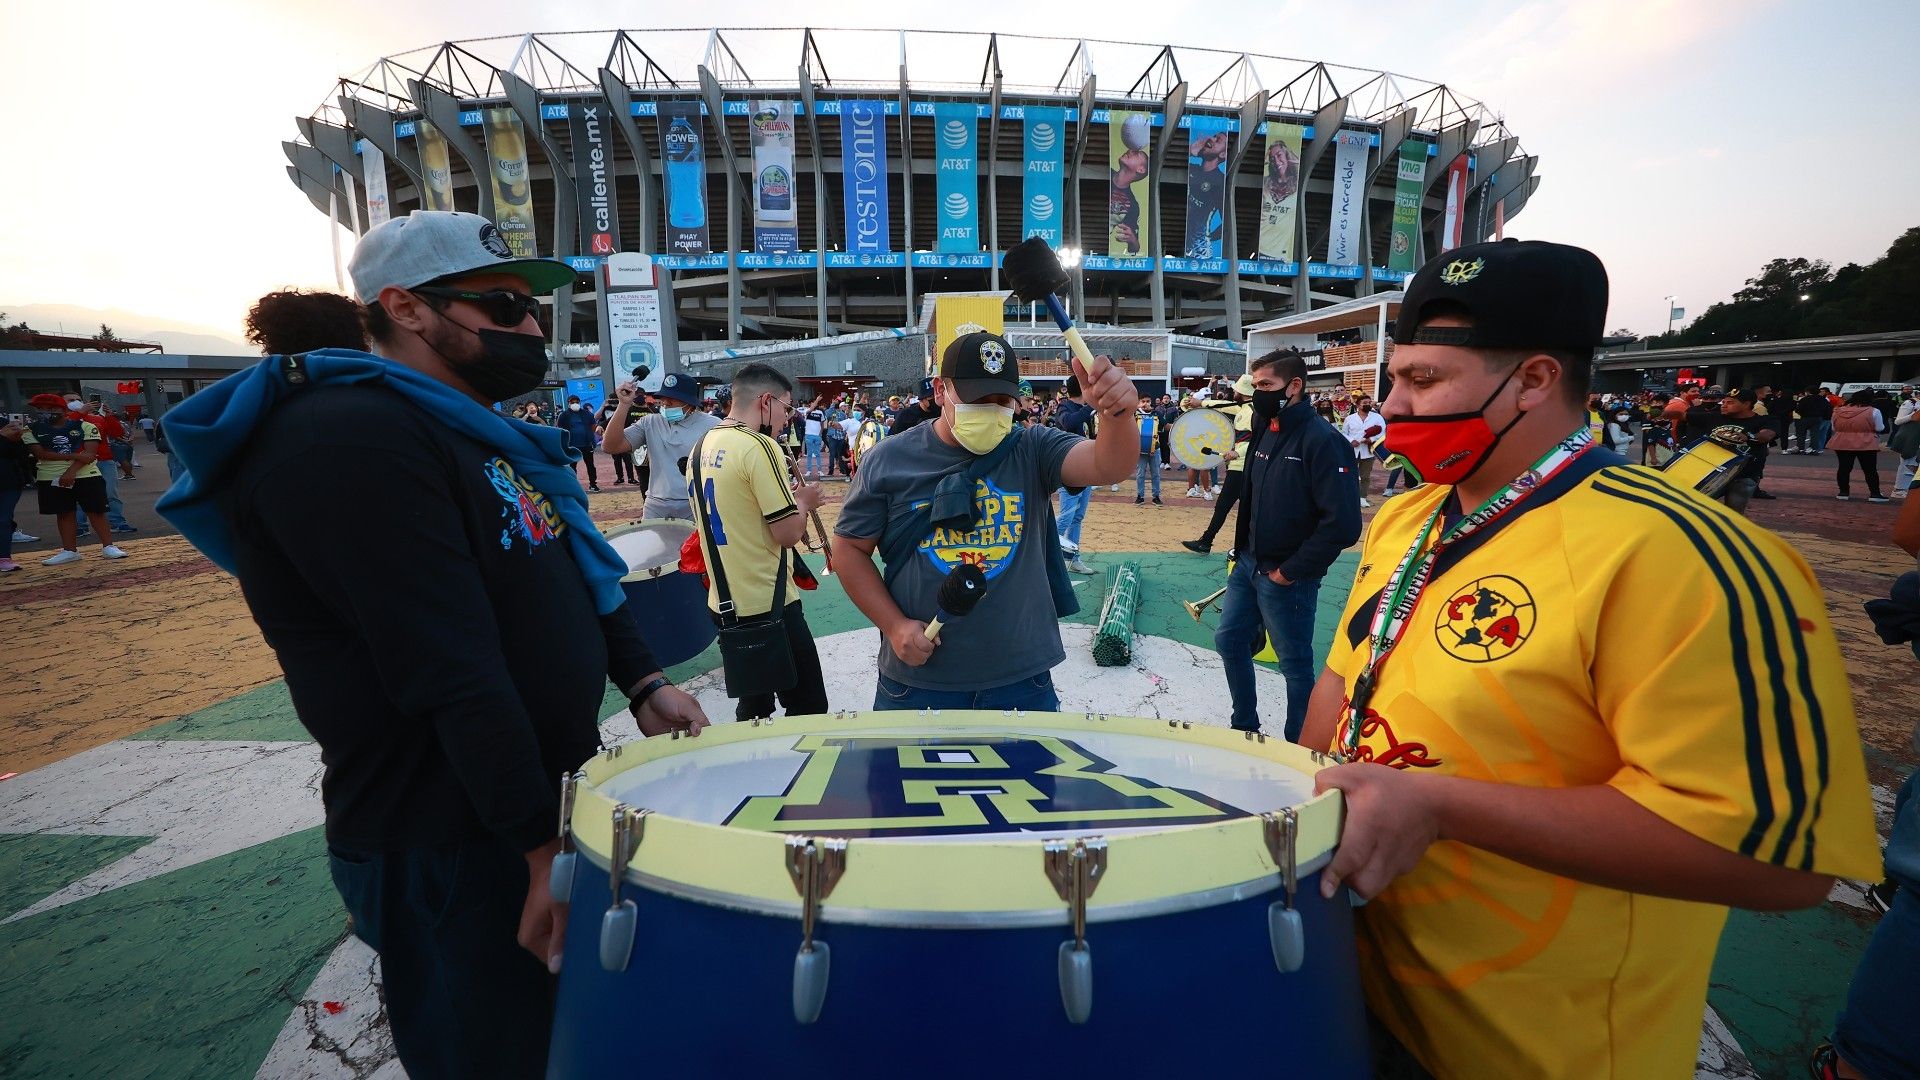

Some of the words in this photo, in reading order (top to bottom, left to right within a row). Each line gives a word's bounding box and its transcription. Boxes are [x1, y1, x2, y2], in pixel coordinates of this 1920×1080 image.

[547, 107, 568, 117] AT&
[638, 103, 657, 114] AT&
[728, 103, 749, 113] AT&
[823, 102, 841, 113] AT&
[914, 102, 935, 114] AT&
[1004, 107, 1024, 118] AT&
[464, 113, 482, 123] AT&
[1092, 111, 1110, 122] AT&
[400, 124, 415, 135] AT&
[665, 134, 699, 143] POWER
[1349, 136, 1366, 146] GNP
[584, 107, 609, 232] caliente.mx
[942, 158, 971, 170] AT&T
[1028, 161, 1057, 172] AT&T
[1396, 198, 1418, 208] FICIAL
[1271, 205, 1291, 214] AT&T
[500, 221, 526, 230] Corona
[1340, 218, 1349, 229] es
[943, 227, 972, 239] AT&T
[1027, 229, 1056, 240] AT&T
[508, 240, 523, 248] ARA
[674, 240, 703, 248] POWER
[1336, 231, 1347, 260] Vivir
[512, 248, 533, 257] ILLAR
[572, 258, 596, 269] AT&T
[657, 256, 681, 267] AT&T
[700, 255, 725, 266] AT&T
[743, 255, 769, 265] AT&T
[786, 255, 812, 265] AT&T
[831, 254, 857, 264] AT&T
[873, 254, 899, 264] AT&T
[918, 254, 944, 265] AT&T
[960, 255, 986, 266] AT&T
[1084, 258, 1108, 268] AT&T
[1123, 258, 1148, 269] AT&T
[1164, 260, 1188, 270] AT&T
[1201, 262, 1224, 271] AT&T
[1238, 261, 1259, 272] AT&T
[1272, 264, 1293, 273] AT&T
[1307, 265, 1326, 275] AT&T
[1175, 336, 1219, 347] VENIDOS
